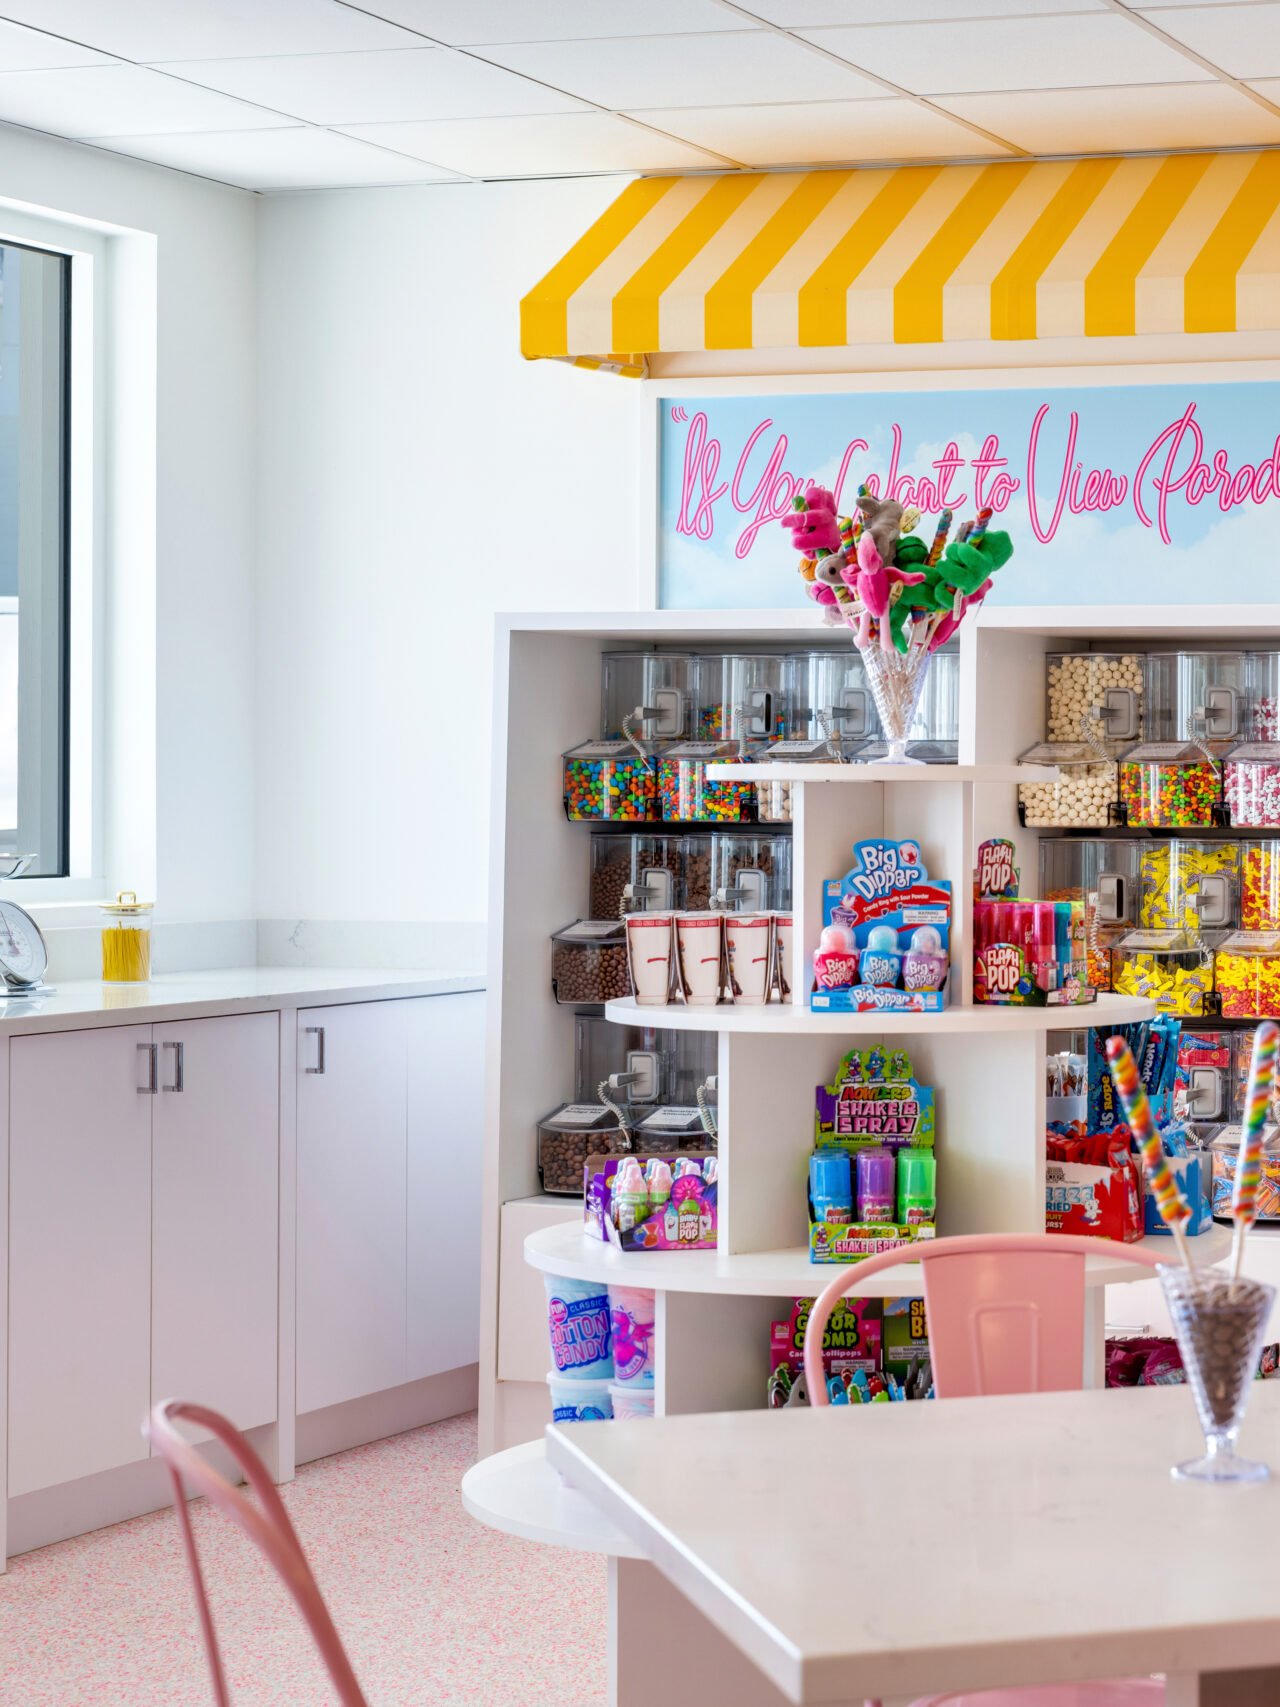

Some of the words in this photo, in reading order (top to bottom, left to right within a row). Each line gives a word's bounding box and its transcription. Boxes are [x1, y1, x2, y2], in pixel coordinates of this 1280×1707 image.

[971, 434, 1020, 515] to
[1027, 403, 1128, 544] View
[860, 844, 898, 873] Big
[982, 844, 1013, 864] FLASH
[851, 868, 920, 900] Dipper
[980, 863, 1012, 892] POP
[869, 956, 889, 971] Big
[986, 945, 1020, 966] FLASH
[825, 957, 847, 974] Big
[909, 960, 929, 976] Big
[821, 970, 854, 988] Dipper
[864, 969, 897, 985] Dipper
[905, 974, 939, 989] Dipper
[986, 965, 1021, 991] POP
[853, 986, 875, 1003] Big
[874, 990, 910, 1008] Dipper
[1142, 1042, 1156, 1082] Nerds
[1101, 1075, 1113, 1111] Rope
[837, 1101, 900, 1116] SHAKE
[837, 1116, 915, 1134] SPRAY
[1046, 1186, 1095, 1203] EEZE
[1046, 1201, 1071, 1212] RIED
[678, 1229, 699, 1240] POP
[835, 1240, 866, 1254] SHAKE
[569, 1298, 604, 1313] CLASSIC
[794, 1331, 858, 1348] COMP
